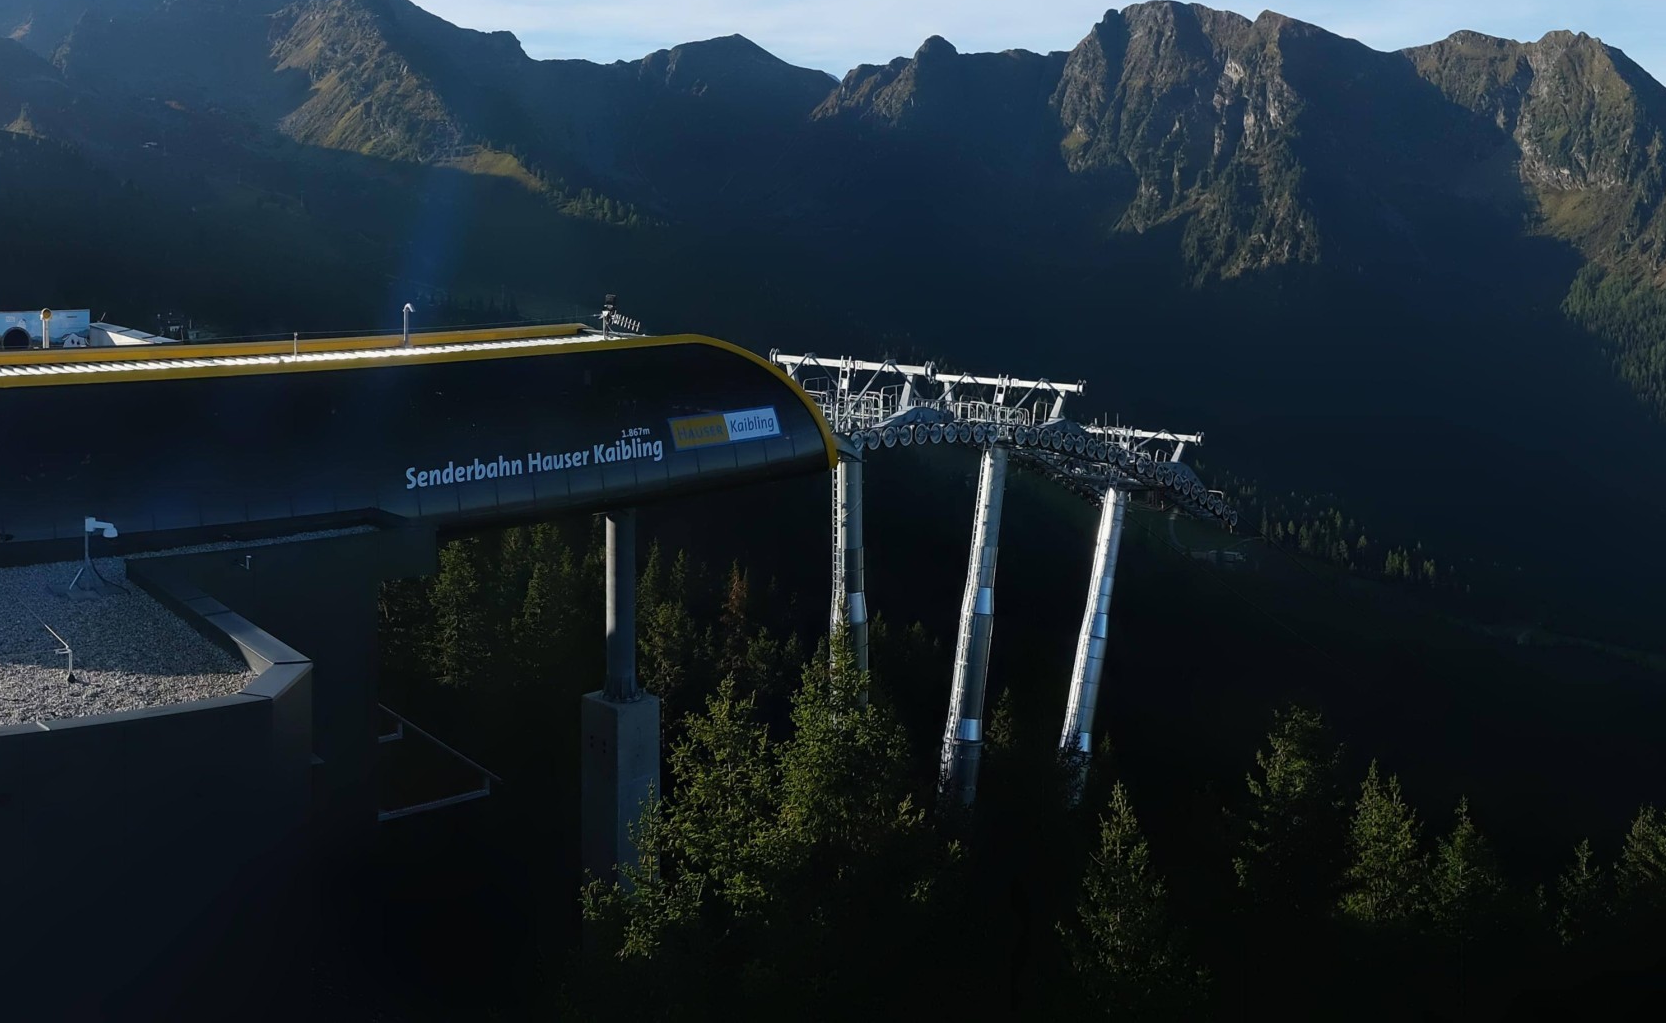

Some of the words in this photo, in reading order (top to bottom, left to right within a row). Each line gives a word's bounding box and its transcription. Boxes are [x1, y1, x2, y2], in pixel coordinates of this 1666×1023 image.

[621, 426, 651, 438] 1.867m
[677, 424, 725, 440] HAUSER
[730, 414, 775, 434] Kaibling
[405, 455, 523, 490] Senderbahn
[527, 448, 590, 474] Hauser
[593, 437, 663, 464] Kaibling
